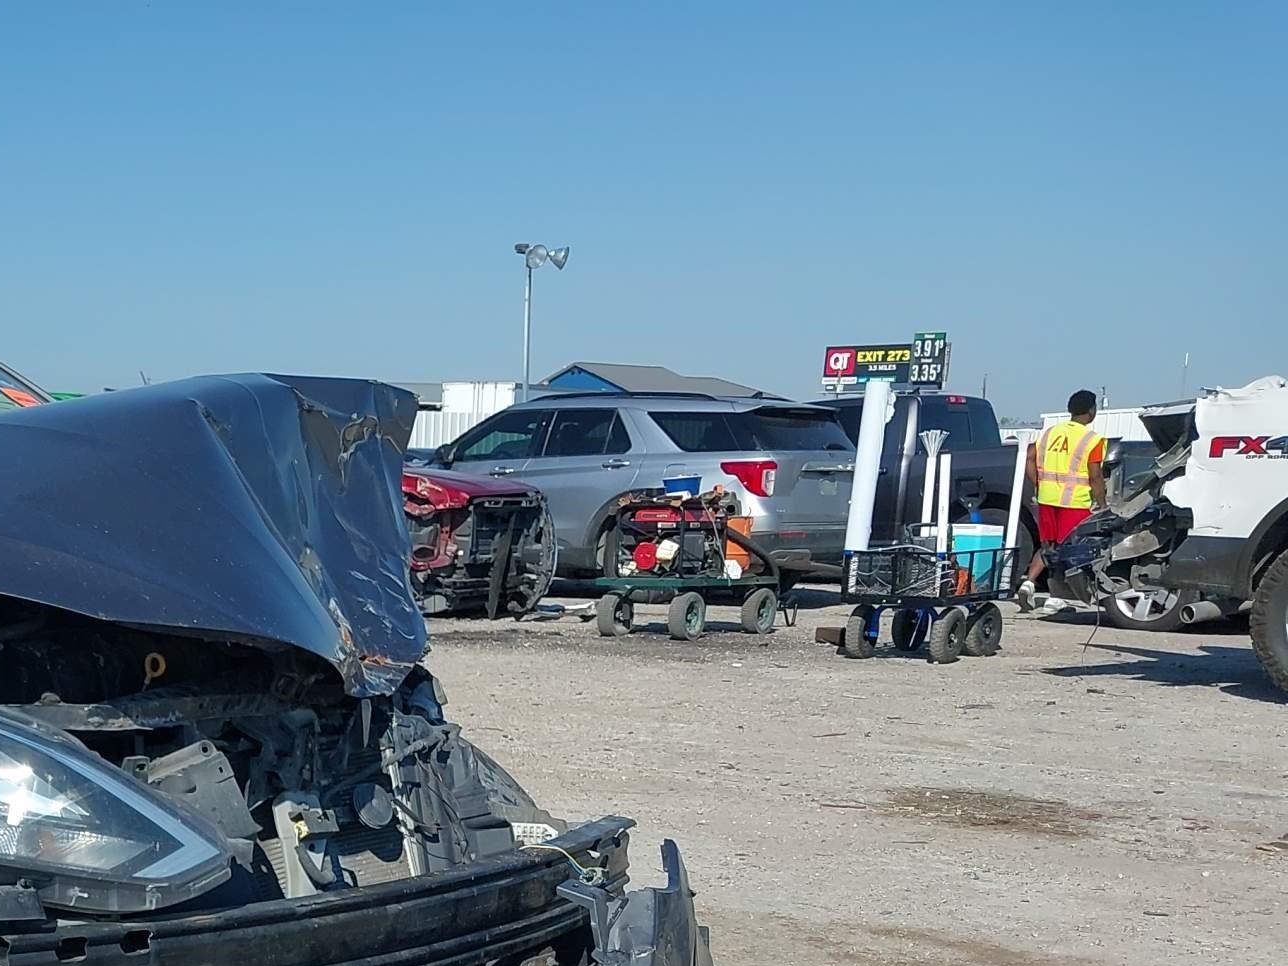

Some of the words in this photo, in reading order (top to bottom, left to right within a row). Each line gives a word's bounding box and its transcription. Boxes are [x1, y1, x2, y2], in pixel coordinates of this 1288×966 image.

[830, 353, 851, 370] QT
[857, 351, 885, 362] EXIT
[887, 351, 910, 361] 273
